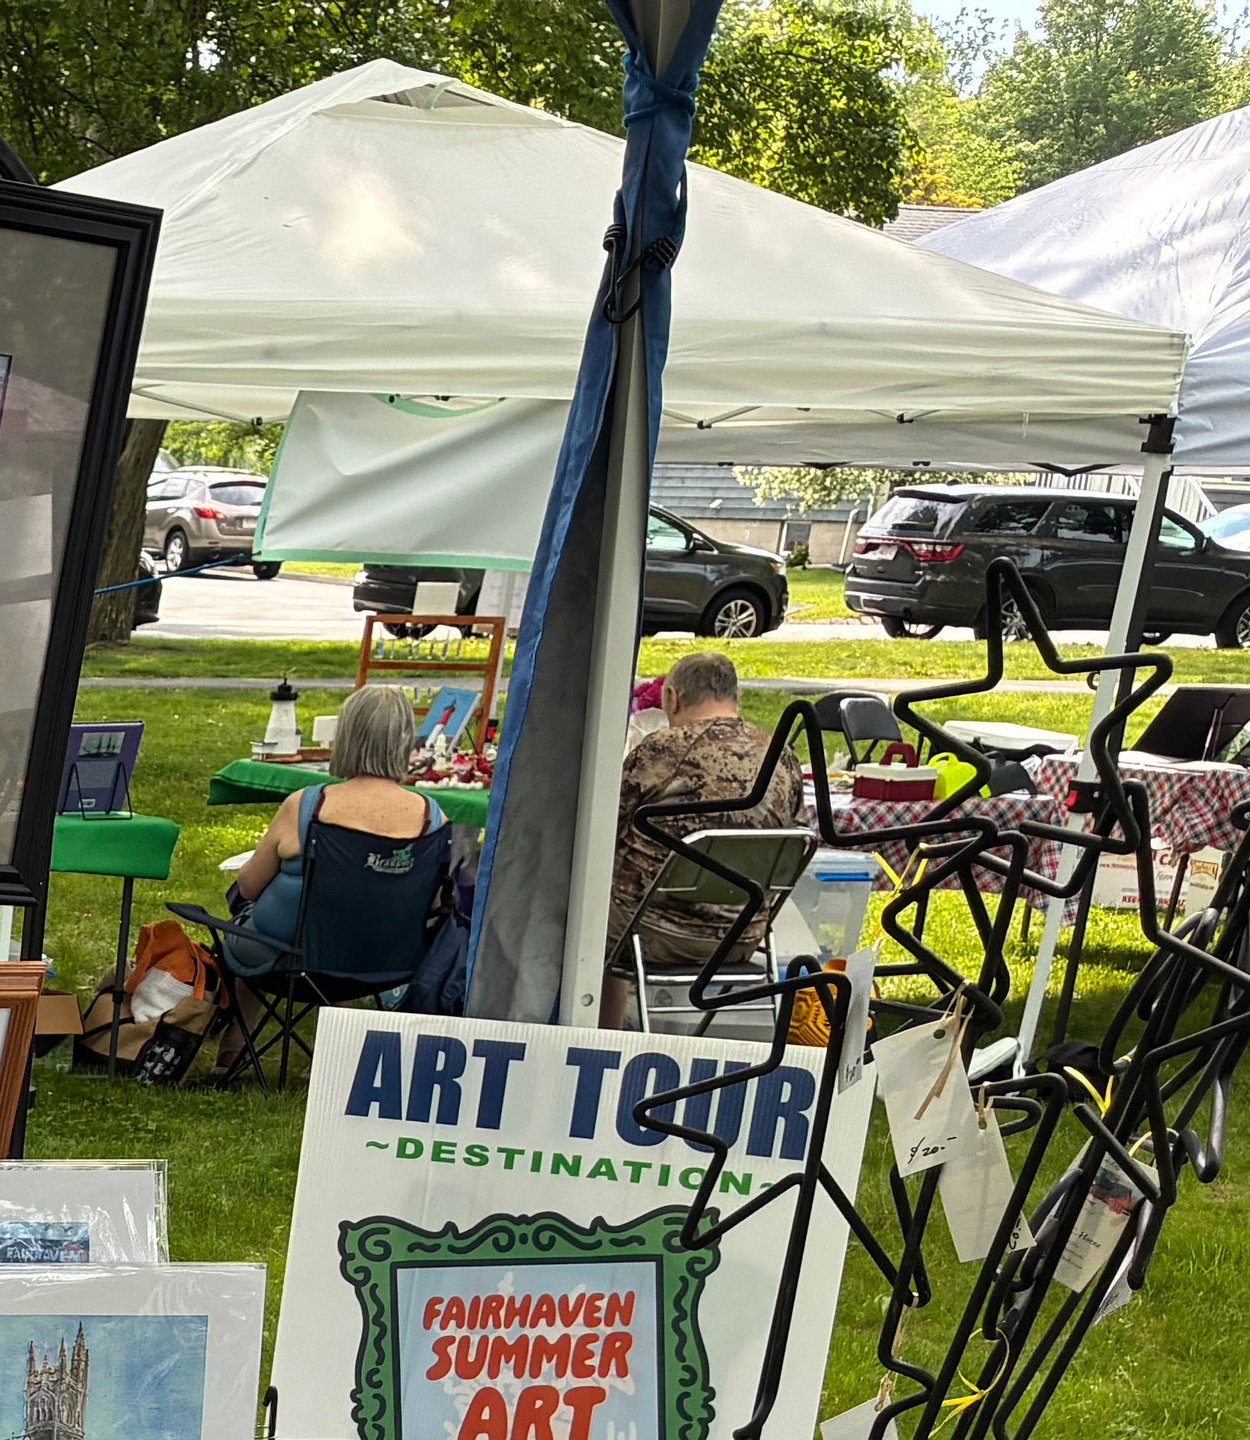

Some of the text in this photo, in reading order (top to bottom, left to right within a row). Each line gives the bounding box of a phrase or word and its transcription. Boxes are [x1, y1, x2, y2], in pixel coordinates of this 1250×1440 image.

[344, 1029, 817, 1162] ART TOUR
[423, 1291, 635, 1331] FAIRHAVEN
[425, 1331, 633, 1381] SUMMER
